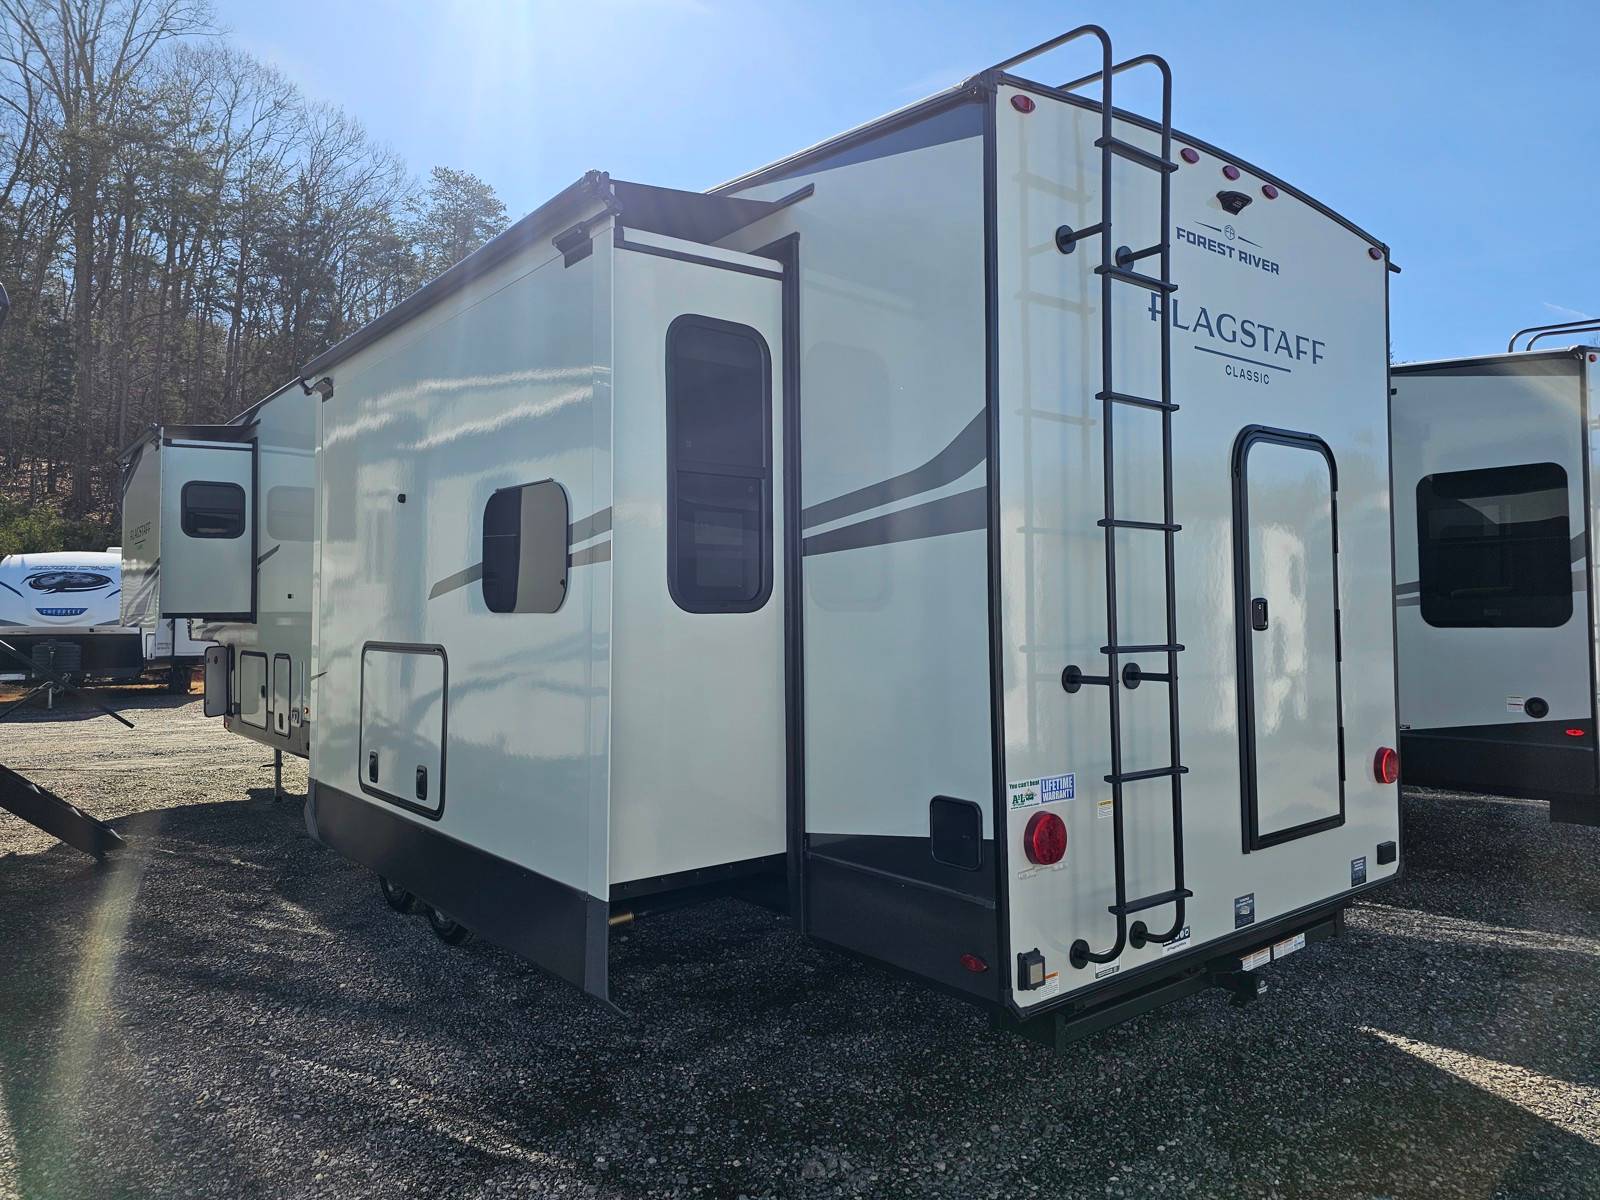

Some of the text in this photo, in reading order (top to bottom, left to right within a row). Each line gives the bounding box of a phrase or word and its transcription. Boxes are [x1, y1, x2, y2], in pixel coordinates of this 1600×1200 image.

[1176, 226, 1280, 275] FOREST RIVER
[1148, 291, 1326, 365] FLAGSTAFF
[1225, 364, 1270, 385] CLASSIC
[1042, 775, 1073, 792] LIFETIME
[1042, 788, 1073, 802] WARRANTY
